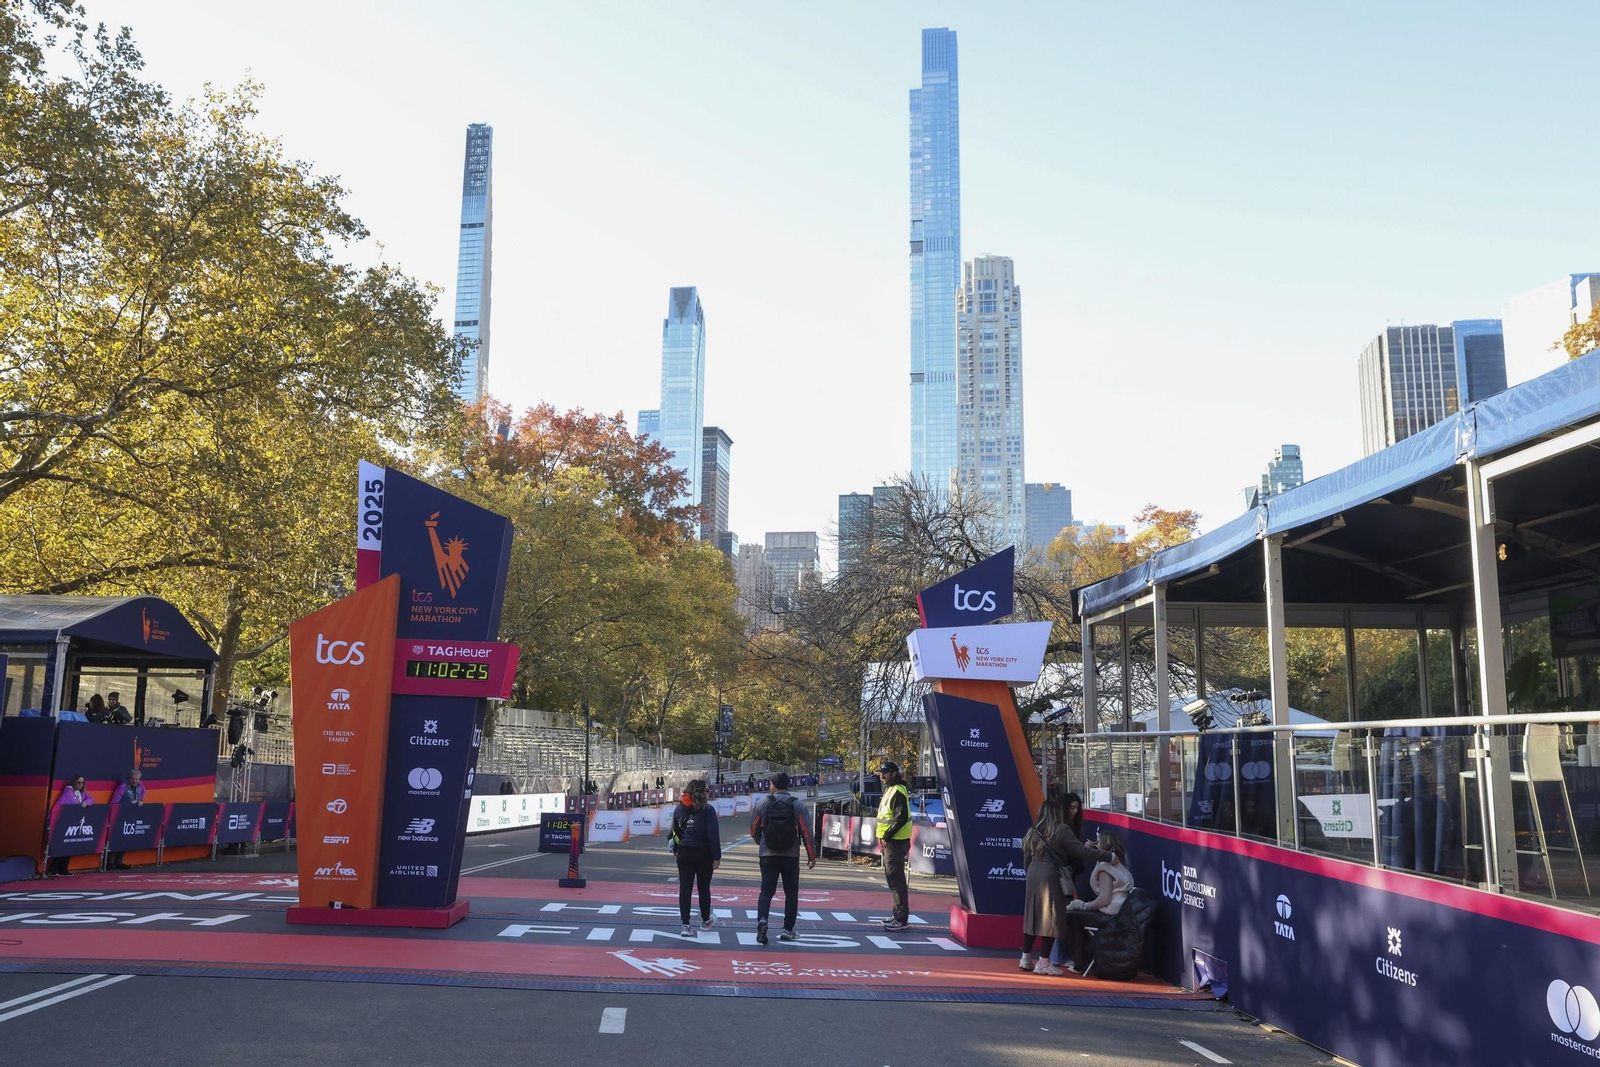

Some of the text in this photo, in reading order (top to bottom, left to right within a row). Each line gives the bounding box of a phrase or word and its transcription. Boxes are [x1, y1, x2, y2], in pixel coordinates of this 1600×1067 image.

[362, 479, 384, 541] 2025
[412, 589, 433, 602] tcs
[954, 584, 996, 612] tcs
[434, 606, 457, 614] YORK
[410, 614, 461, 623] MARATHON
[316, 633, 365, 666] tcs
[976, 646, 990, 655] tcs
[410, 736, 449, 746] Citizens
[64, 826, 94, 836] NYRR
[123, 821, 135, 835] tcs
[922, 843, 935, 858] tcs
[314, 867, 358, 876] NYRR
[1183, 865, 1197, 879] TATA
[1162, 860, 1182, 902] tcs
[1183, 880, 1216, 898] CONSULTANCY
[1183, 894, 1204, 909] SERVICES
[497, 924, 968, 951] FINISH
[1274, 920, 1295, 941] TATA
[1376, 956, 1417, 987] Citizens
[1550, 1032, 1600, 1059] mastercard
